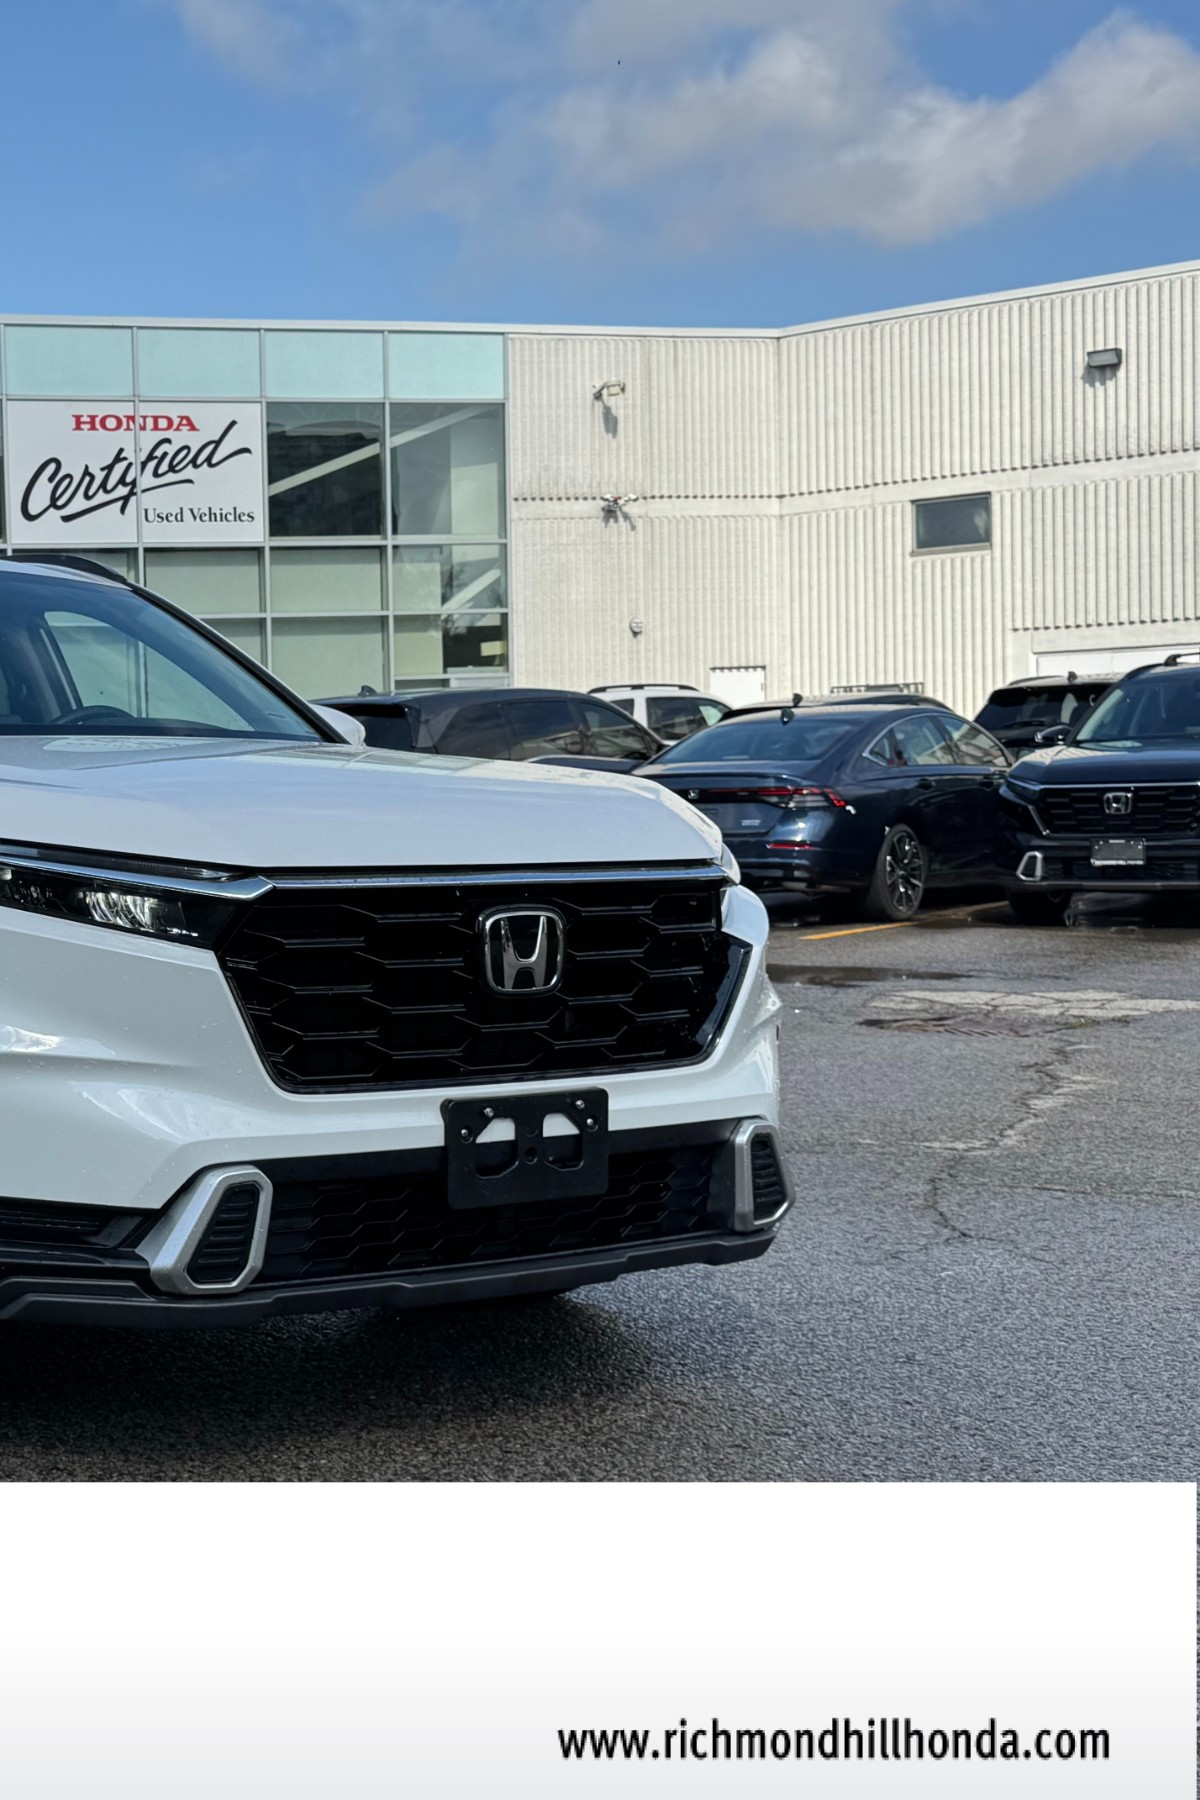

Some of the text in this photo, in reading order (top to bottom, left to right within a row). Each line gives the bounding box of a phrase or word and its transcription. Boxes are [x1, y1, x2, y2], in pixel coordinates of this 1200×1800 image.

[72, 414, 200, 432] HONDA
[20, 419, 252, 523] Certified
[143, 507, 255, 523] Used Vehicles
